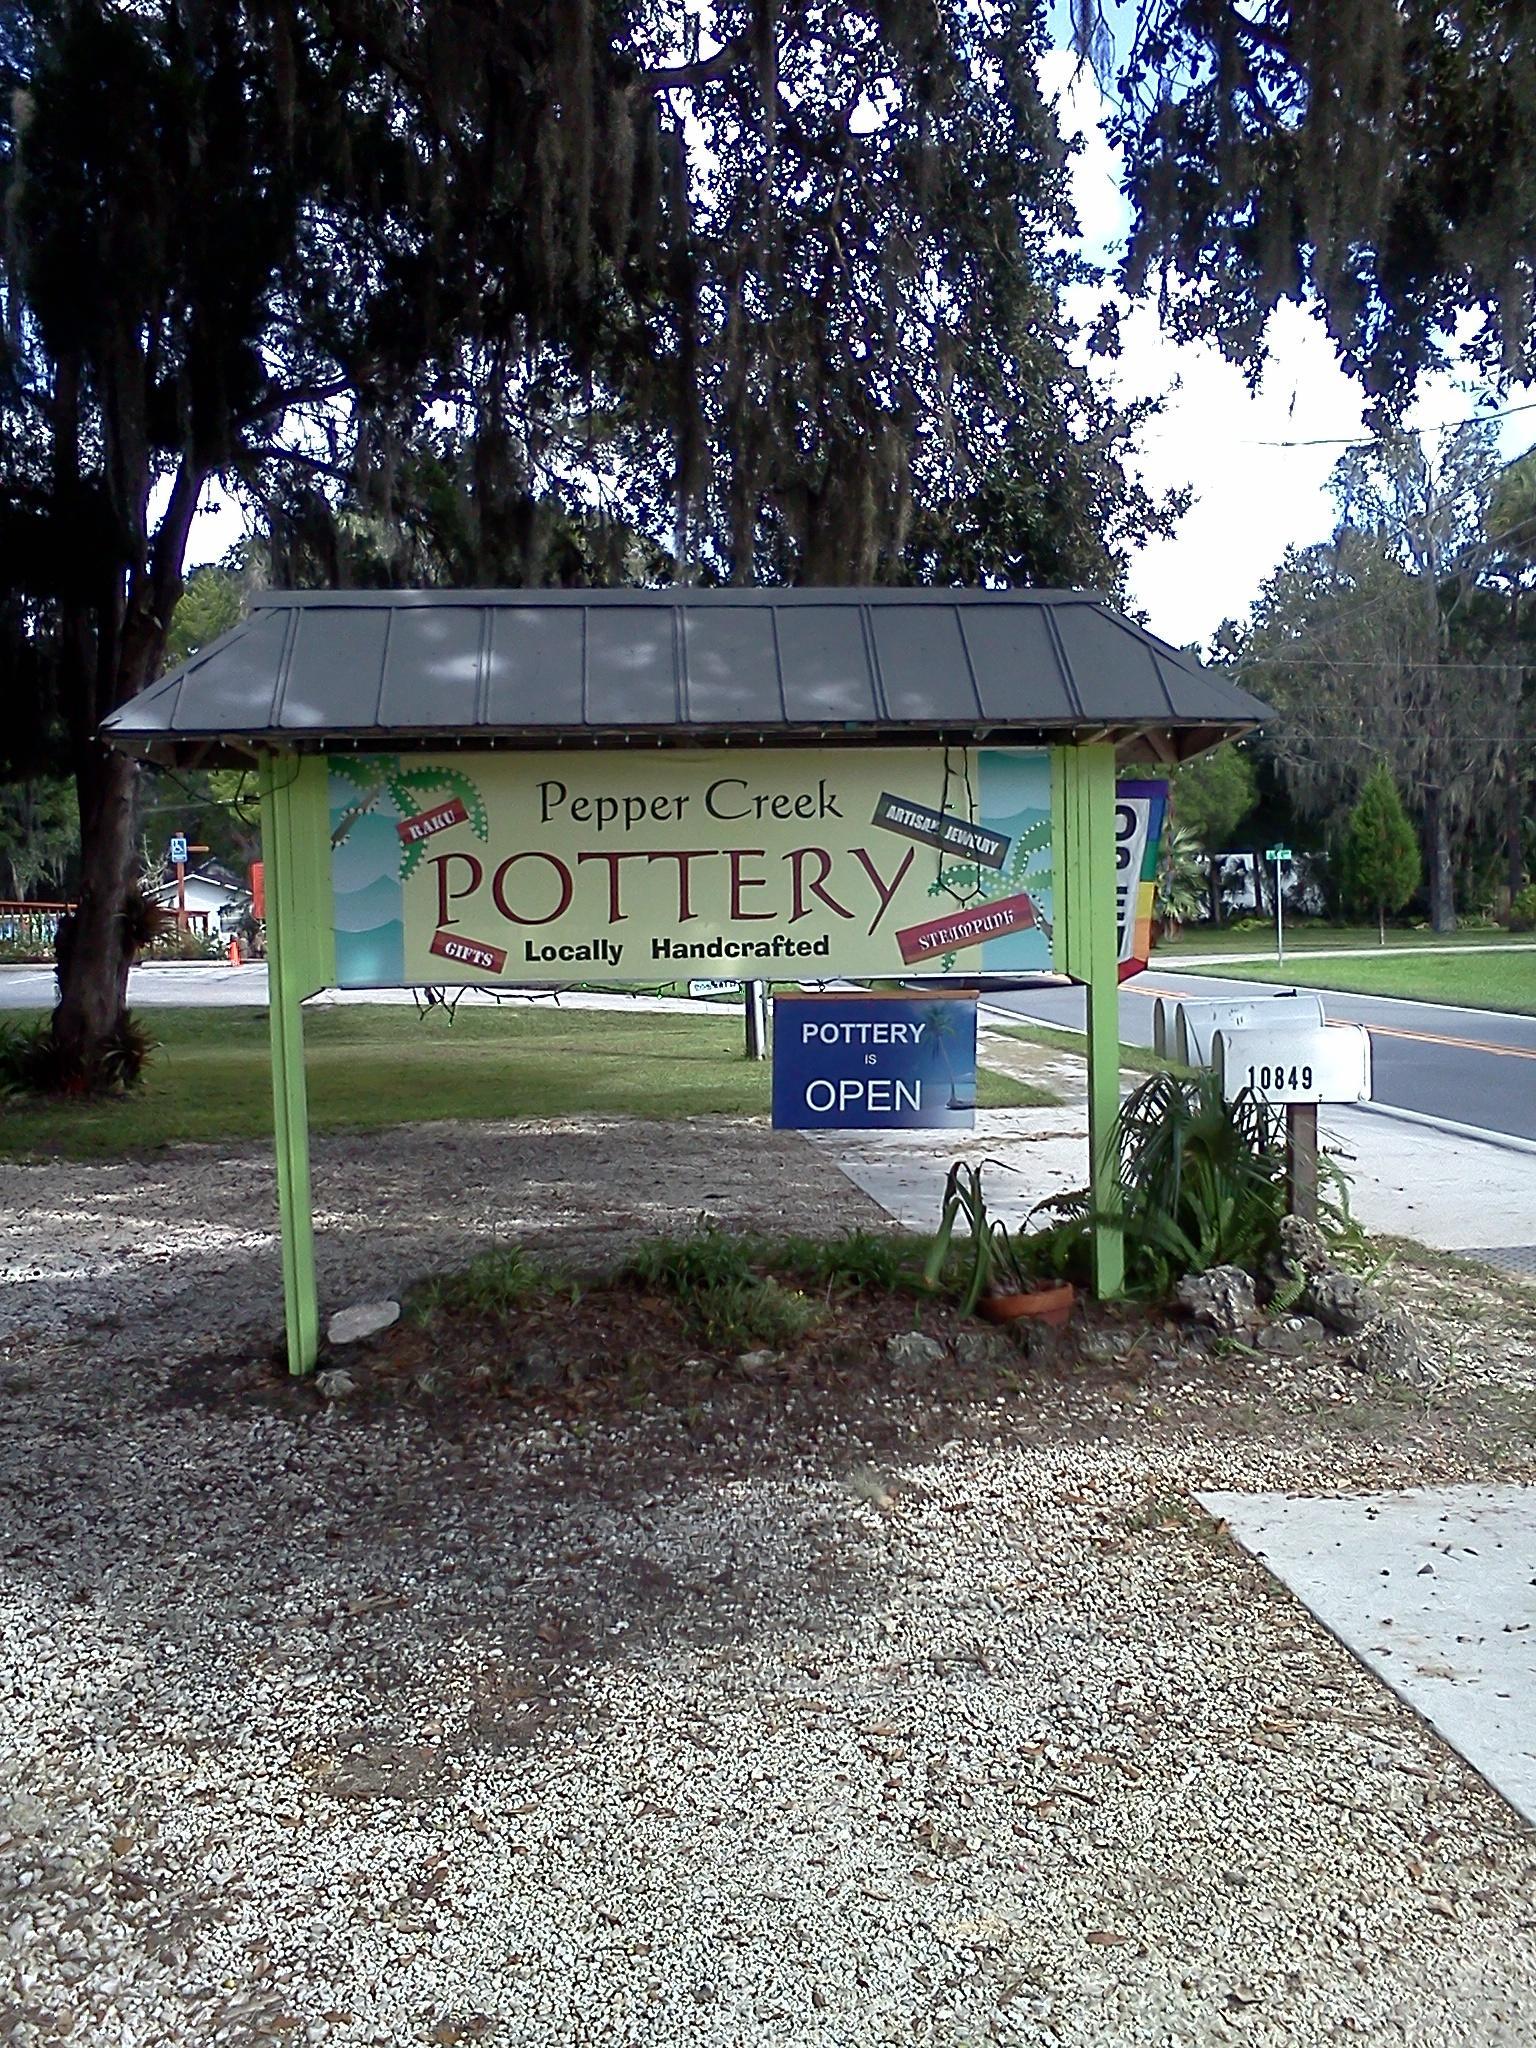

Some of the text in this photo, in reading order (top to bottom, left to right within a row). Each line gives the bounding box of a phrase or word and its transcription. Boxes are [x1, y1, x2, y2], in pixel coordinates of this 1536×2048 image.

[536, 778, 844, 832] Pepper Creek
[408, 809, 456, 840] RAKU
[427, 846, 914, 936] POTTERY
[918, 909, 1014, 950] STEAMPUNK
[445, 941, 494, 967] GIFTS
[525, 935, 830, 966] Locally Handcrafted
[802, 1023, 926, 1044] POTTERY
[864, 1053, 877, 1065] IS
[1248, 1066, 1312, 1090] 10849
[805, 1079, 921, 1112] OPEN
